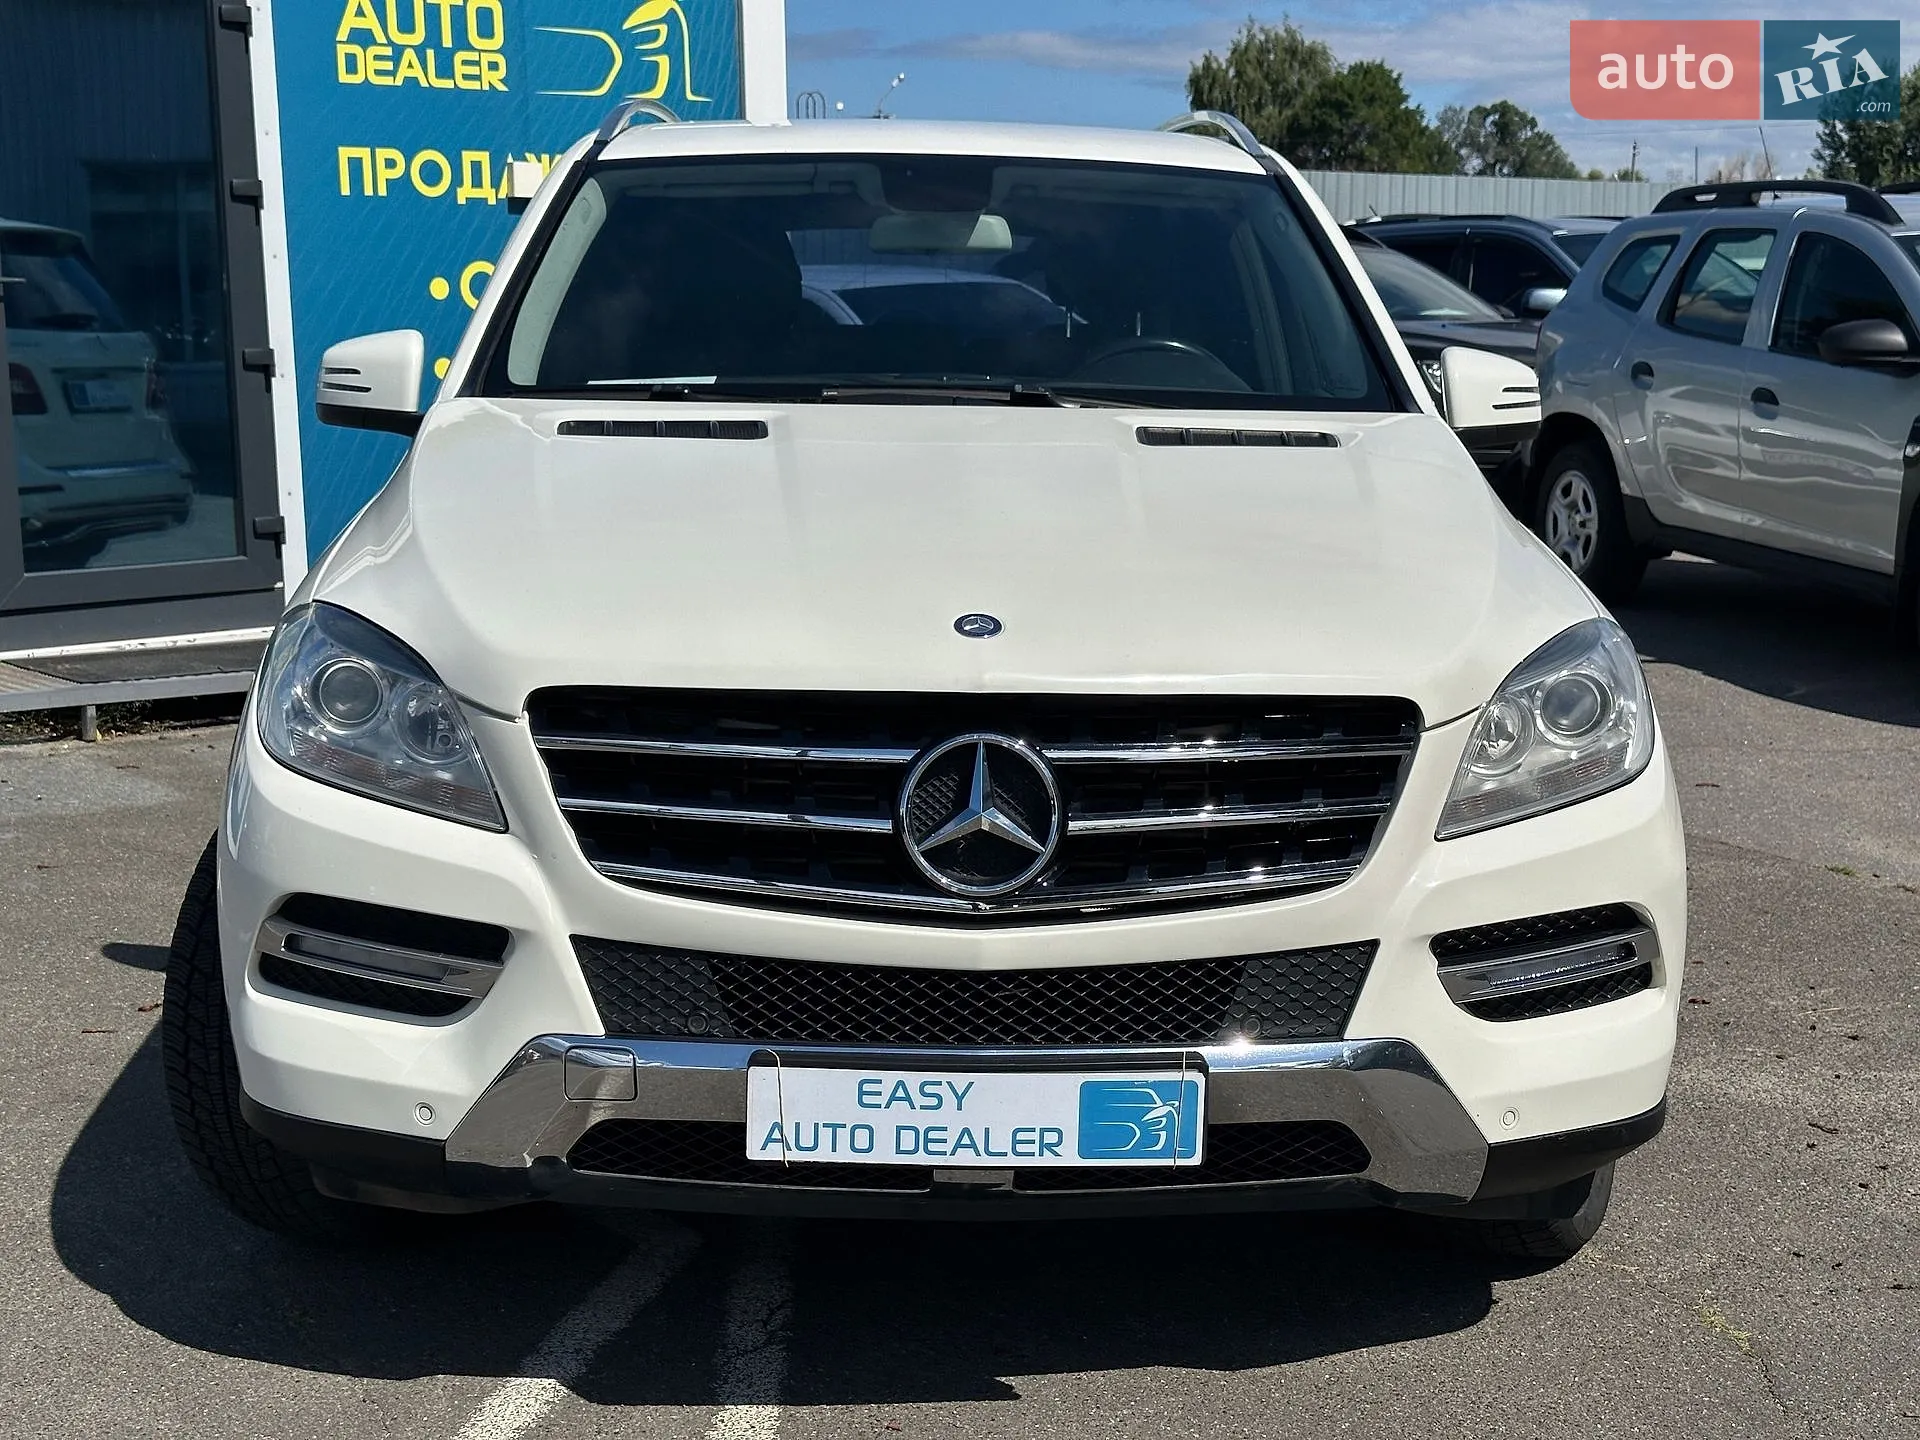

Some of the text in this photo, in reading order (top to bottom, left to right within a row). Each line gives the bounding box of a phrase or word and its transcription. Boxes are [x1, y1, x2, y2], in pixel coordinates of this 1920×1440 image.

[336, 0, 505, 51] AUTO
[336, 43, 510, 92] DEALER
[337, 147, 563, 205] ПРОД
[856, 1078, 975, 1111] EASY
[760, 1121, 1064, 1157] AUTO DEALER
